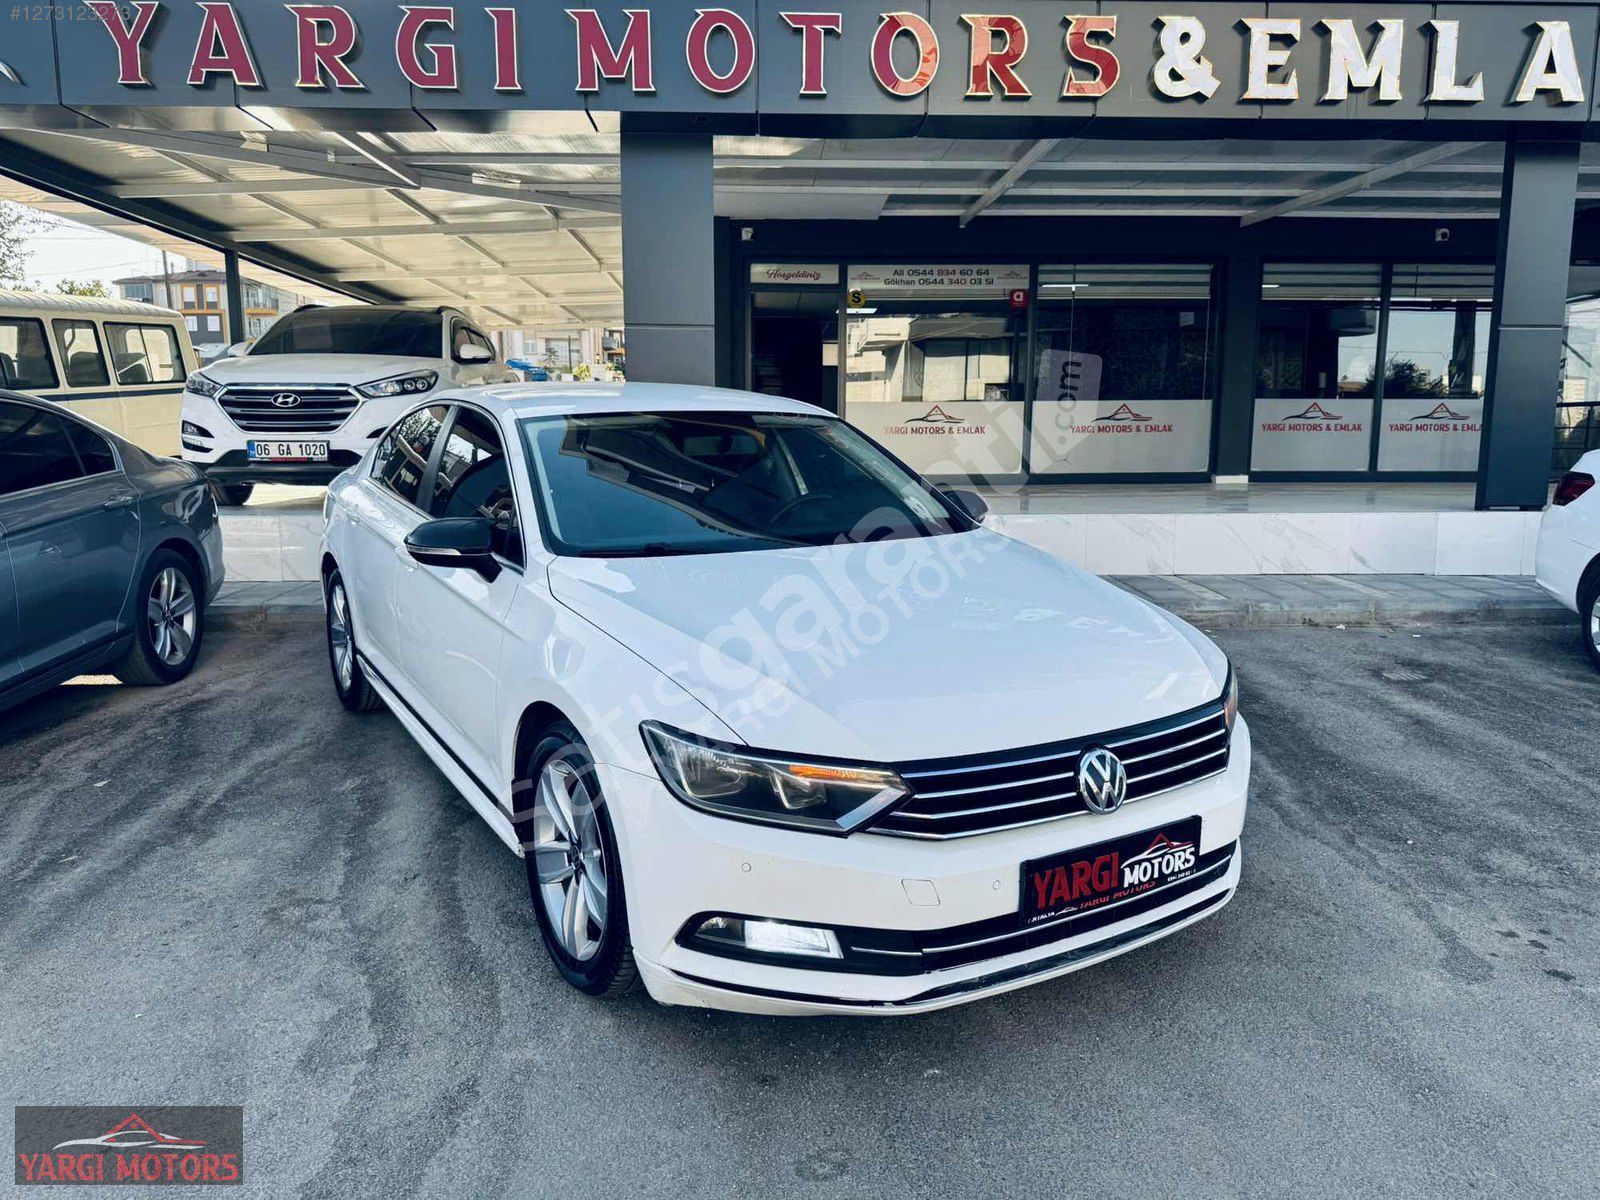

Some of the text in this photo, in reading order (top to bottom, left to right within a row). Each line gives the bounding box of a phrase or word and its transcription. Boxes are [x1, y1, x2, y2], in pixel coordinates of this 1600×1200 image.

[83, 0, 523, 91] YARGI
[563, 7, 1121, 98] MOTORS
[884, 426, 985, 434] YARGI MOTORS & EMLAK
[1070, 424, 1173, 433] YARGI MOTORS & EMLAK
[1261, 423, 1362, 431] YARGI MOTORS & EMLAK
[1389, 423, 1412, 431] YARGI
[1415, 423, 1450, 431] MOTORS
[1452, 423, 1459, 431] &
[256, 444, 270, 456] 06
[278, 444, 292, 456] GA
[299, 444, 326, 456] 1020
[1034, 847, 1196, 909] YARGI MOTORS
